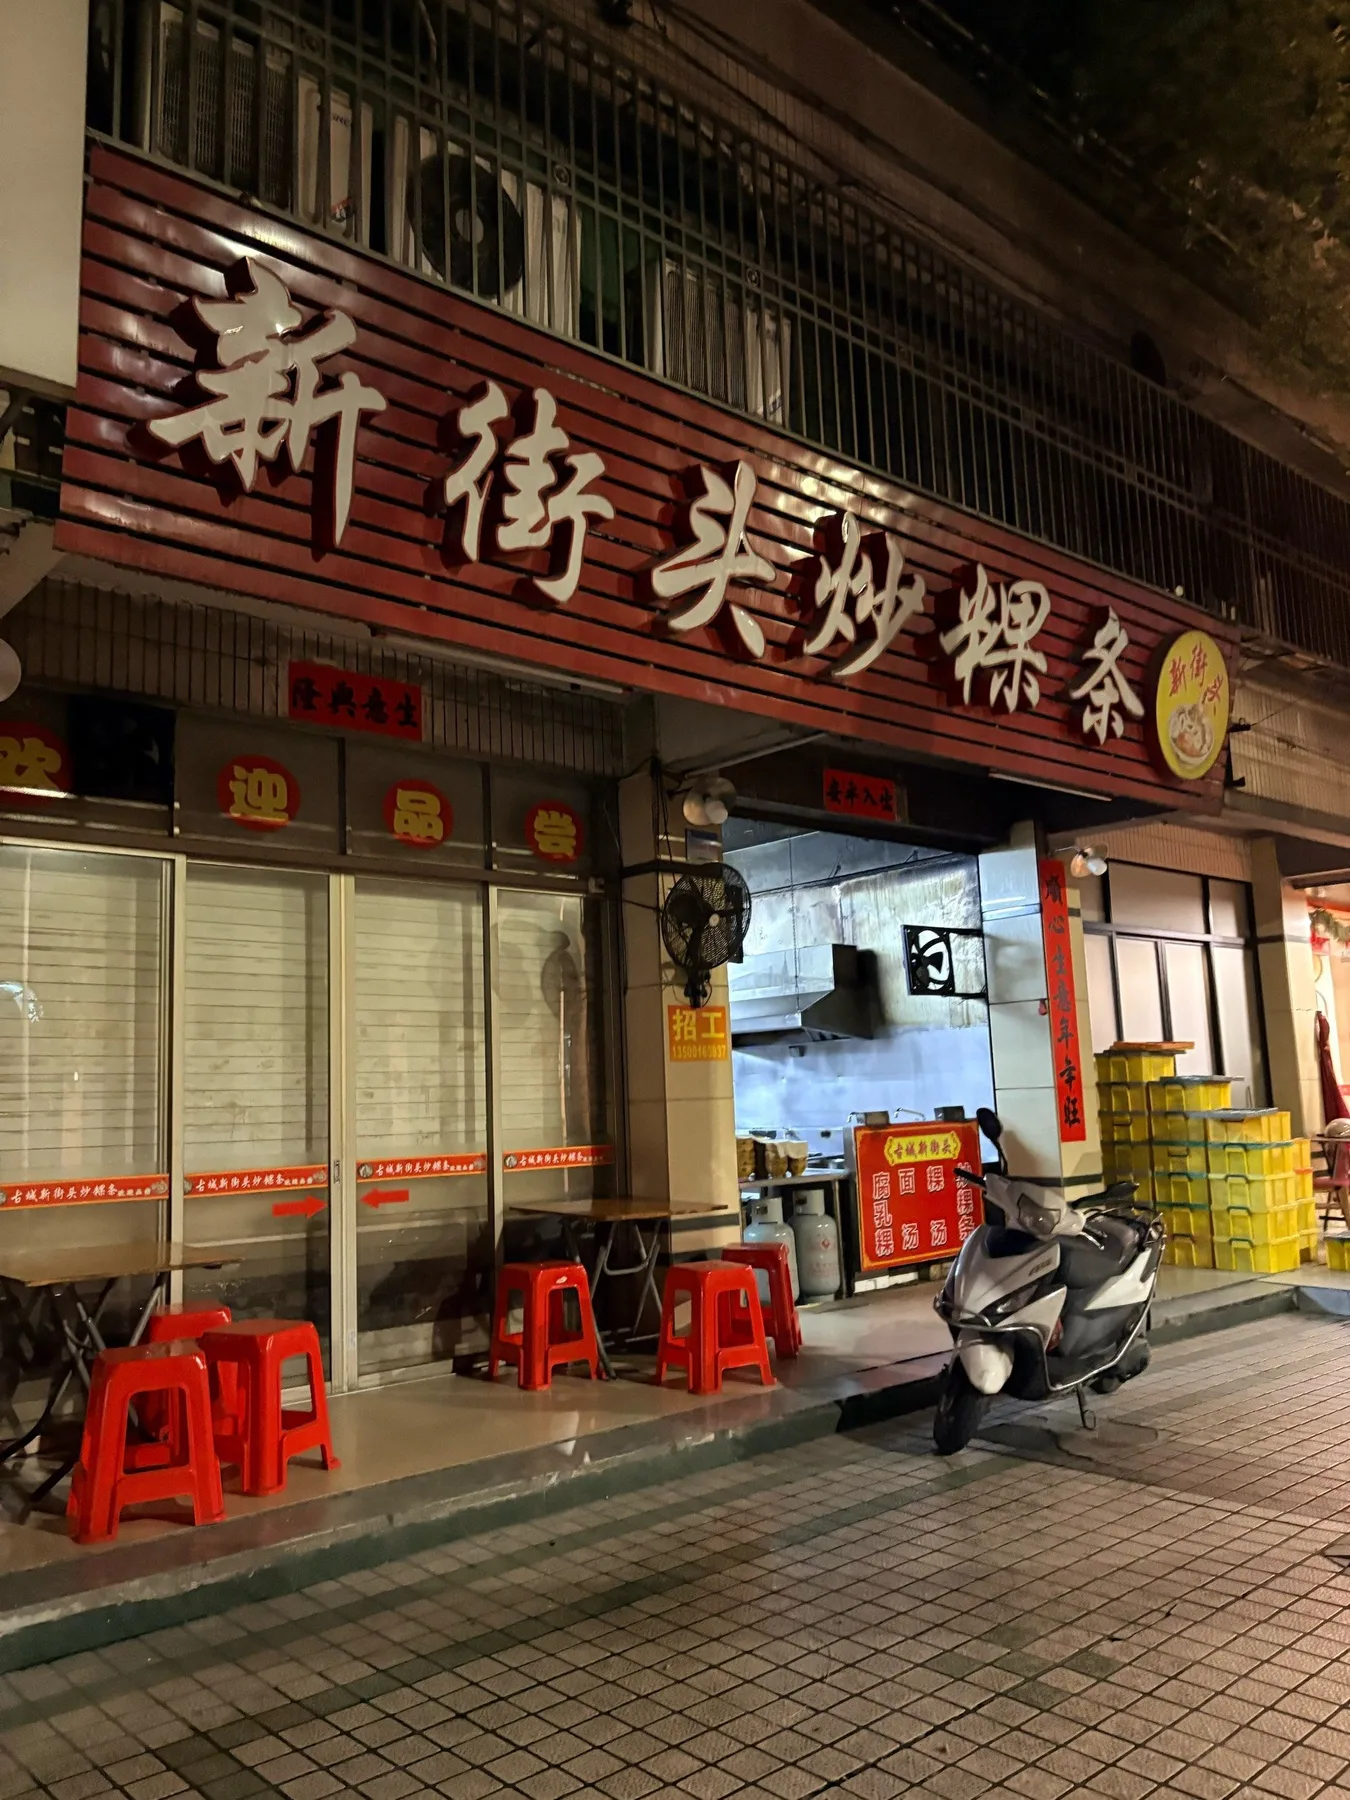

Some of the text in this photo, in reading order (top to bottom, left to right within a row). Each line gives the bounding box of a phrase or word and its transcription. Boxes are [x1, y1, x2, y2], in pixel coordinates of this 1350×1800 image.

[150, 256, 1144, 745] 新街头炒粿条
[229, 764, 290, 823] 迎
[393, 787, 444, 843] 品
[672, 1008, 725, 1041] 招工
